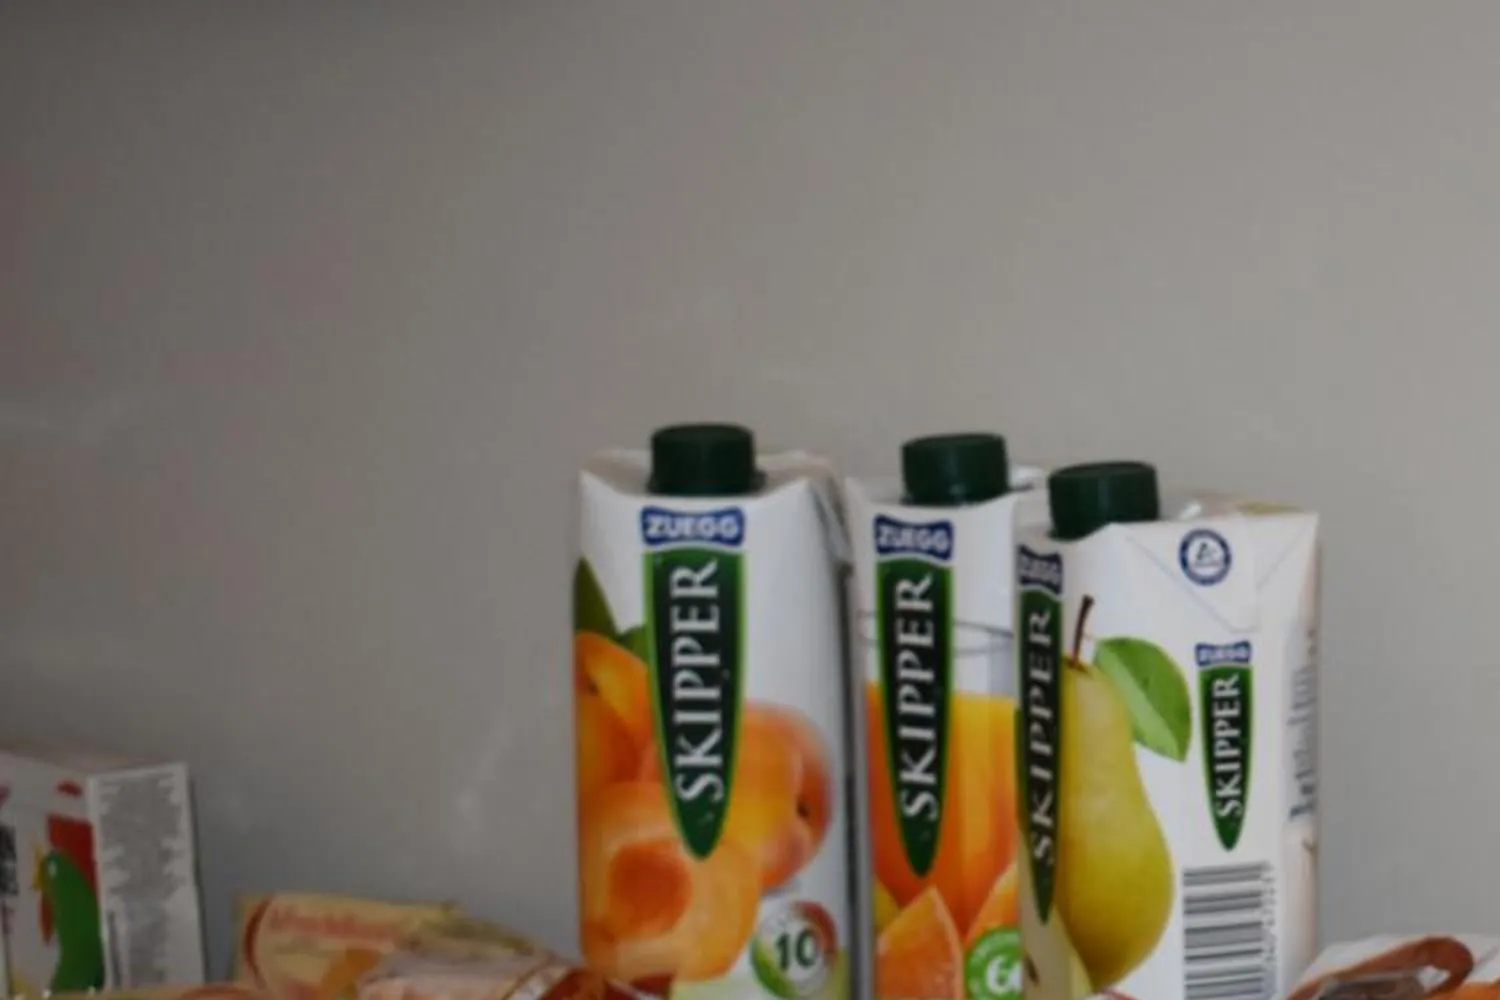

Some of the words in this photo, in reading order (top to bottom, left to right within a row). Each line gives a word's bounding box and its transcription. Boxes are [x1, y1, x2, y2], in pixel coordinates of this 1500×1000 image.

[646, 513, 740, 540] ZUEGG
[878, 526, 951, 553] ZUEGG
[669, 558, 724, 802] SKIPPER
[896, 571, 939, 822] SKIPPER
[1029, 609, 1056, 866] SKIPPER
[1213, 673, 1243, 819] SKIPPER
[774, 927, 819, 972] 10
